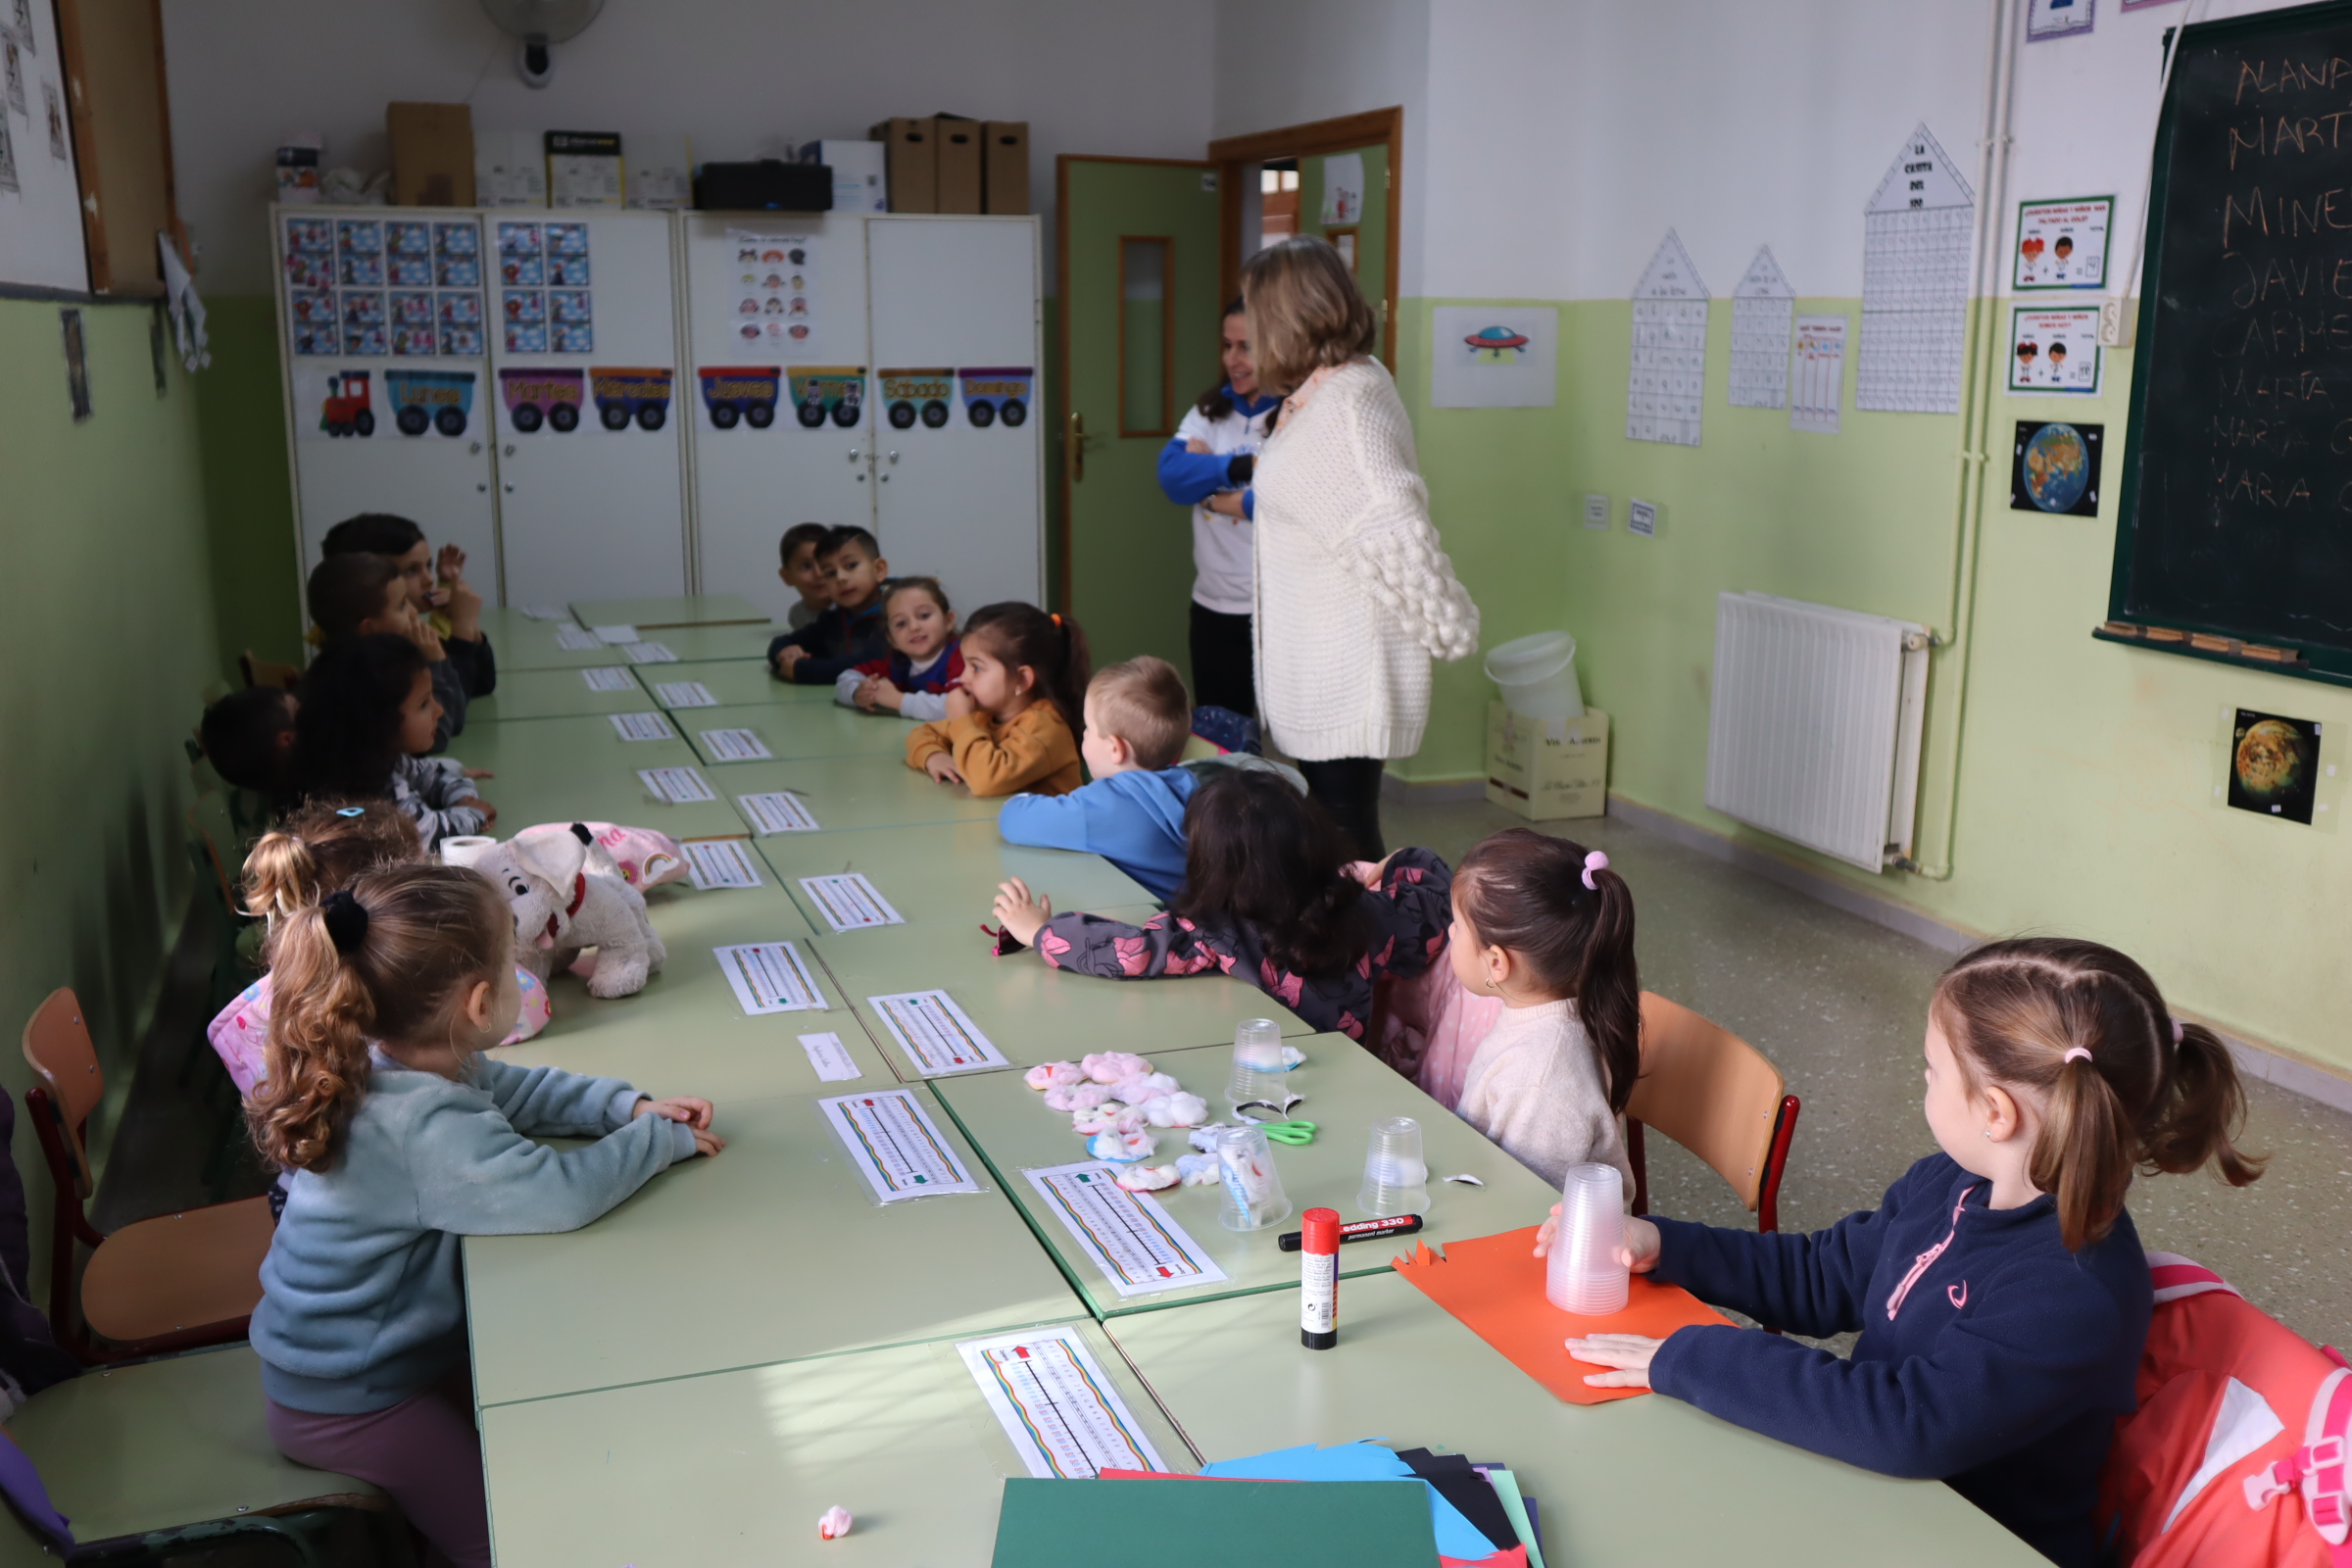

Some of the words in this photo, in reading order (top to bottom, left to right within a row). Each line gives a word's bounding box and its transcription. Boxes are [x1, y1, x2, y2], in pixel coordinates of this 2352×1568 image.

[1915, 144, 1925, 155] LA
[1904, 161, 1933, 174] CASITA
[1910, 179, 1924, 191] DEL
[400, 380, 462, 406] Lunes
[508, 378, 579, 402] Martes
[708, 376, 775, 400] Jueves
[884, 378, 951, 400] Sábado
[965, 378, 1028, 400] Domingo
[1343, 1221, 1379, 1232] edding
[1381, 1218, 1404, 1227] 330
[1348, 1230, 1376, 1241] permanent
